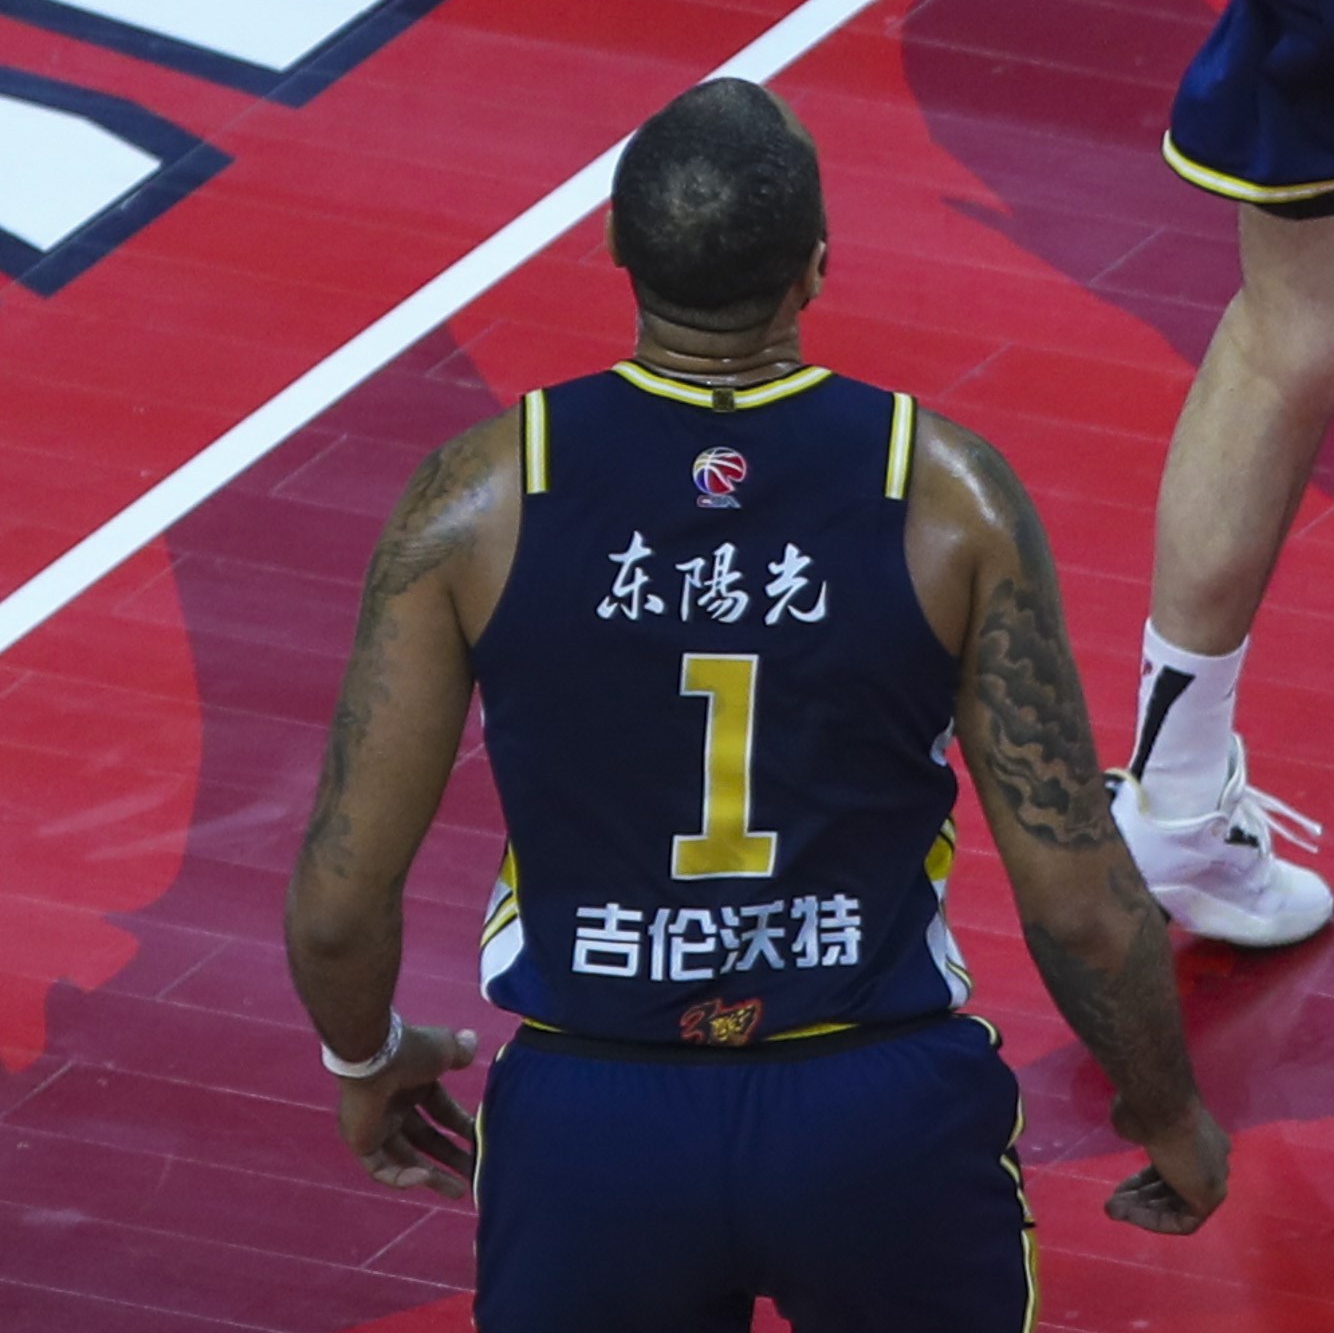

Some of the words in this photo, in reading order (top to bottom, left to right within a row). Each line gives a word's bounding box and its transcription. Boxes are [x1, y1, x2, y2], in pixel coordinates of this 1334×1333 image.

[671, 653, 778, 882] 1
[572, 894, 861, 983] 吉伦沃特
